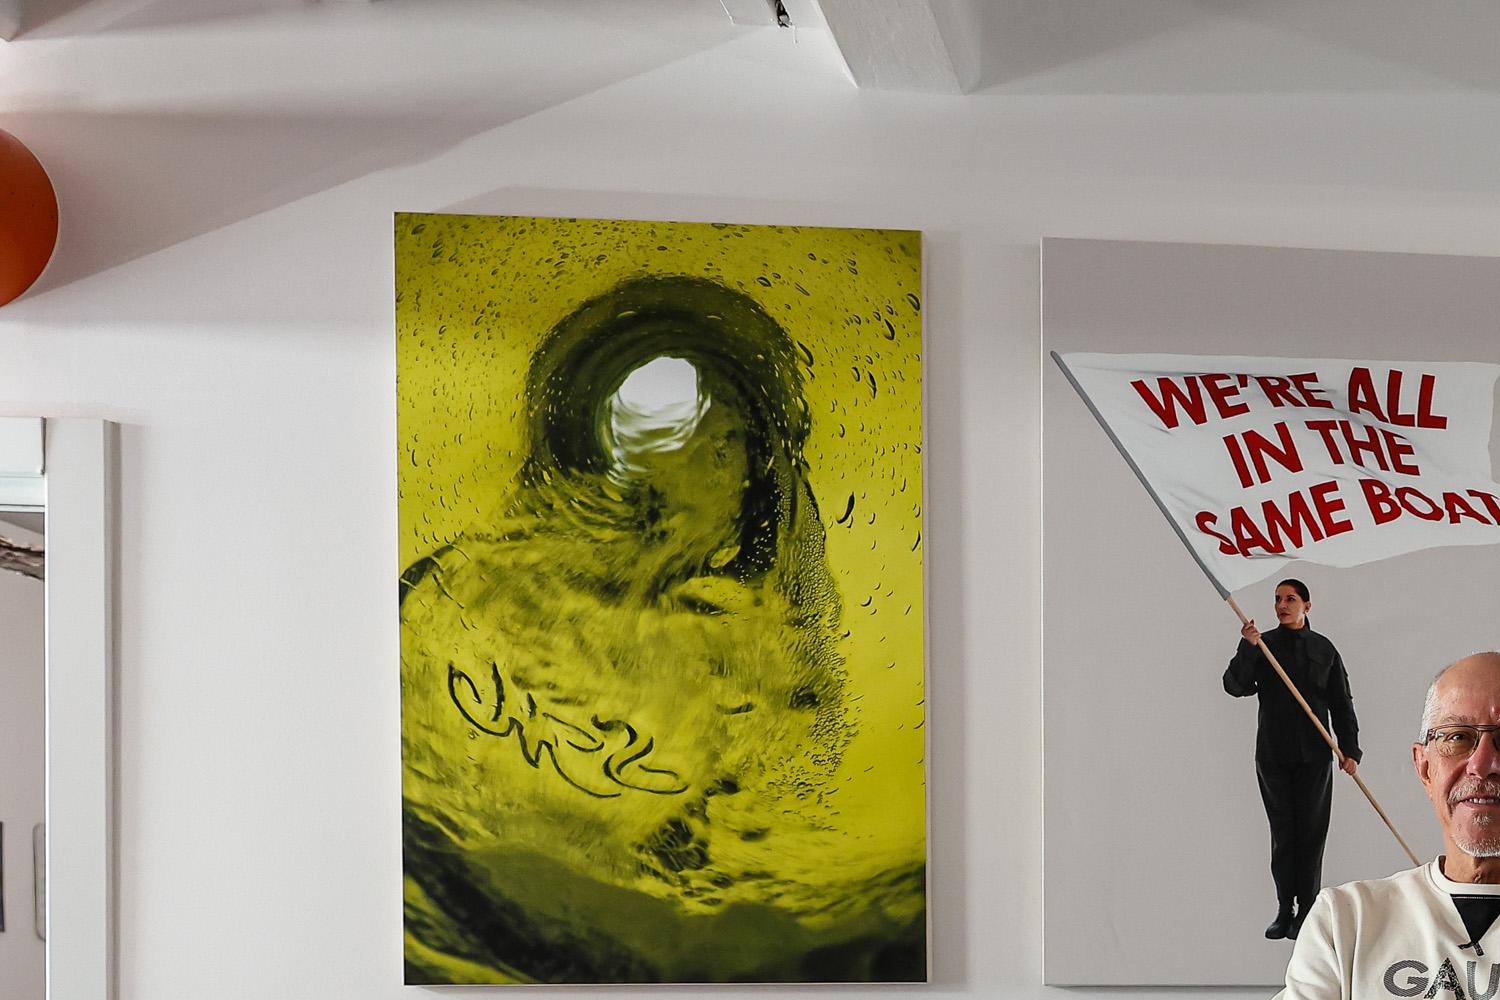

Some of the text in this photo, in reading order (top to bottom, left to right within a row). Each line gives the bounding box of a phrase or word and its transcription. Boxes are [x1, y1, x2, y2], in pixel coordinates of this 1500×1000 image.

[1131, 367, 1448, 429] WE'RE ALL
[1223, 420, 1420, 488] IN THE
[1195, 480, 1354, 558] SAME
